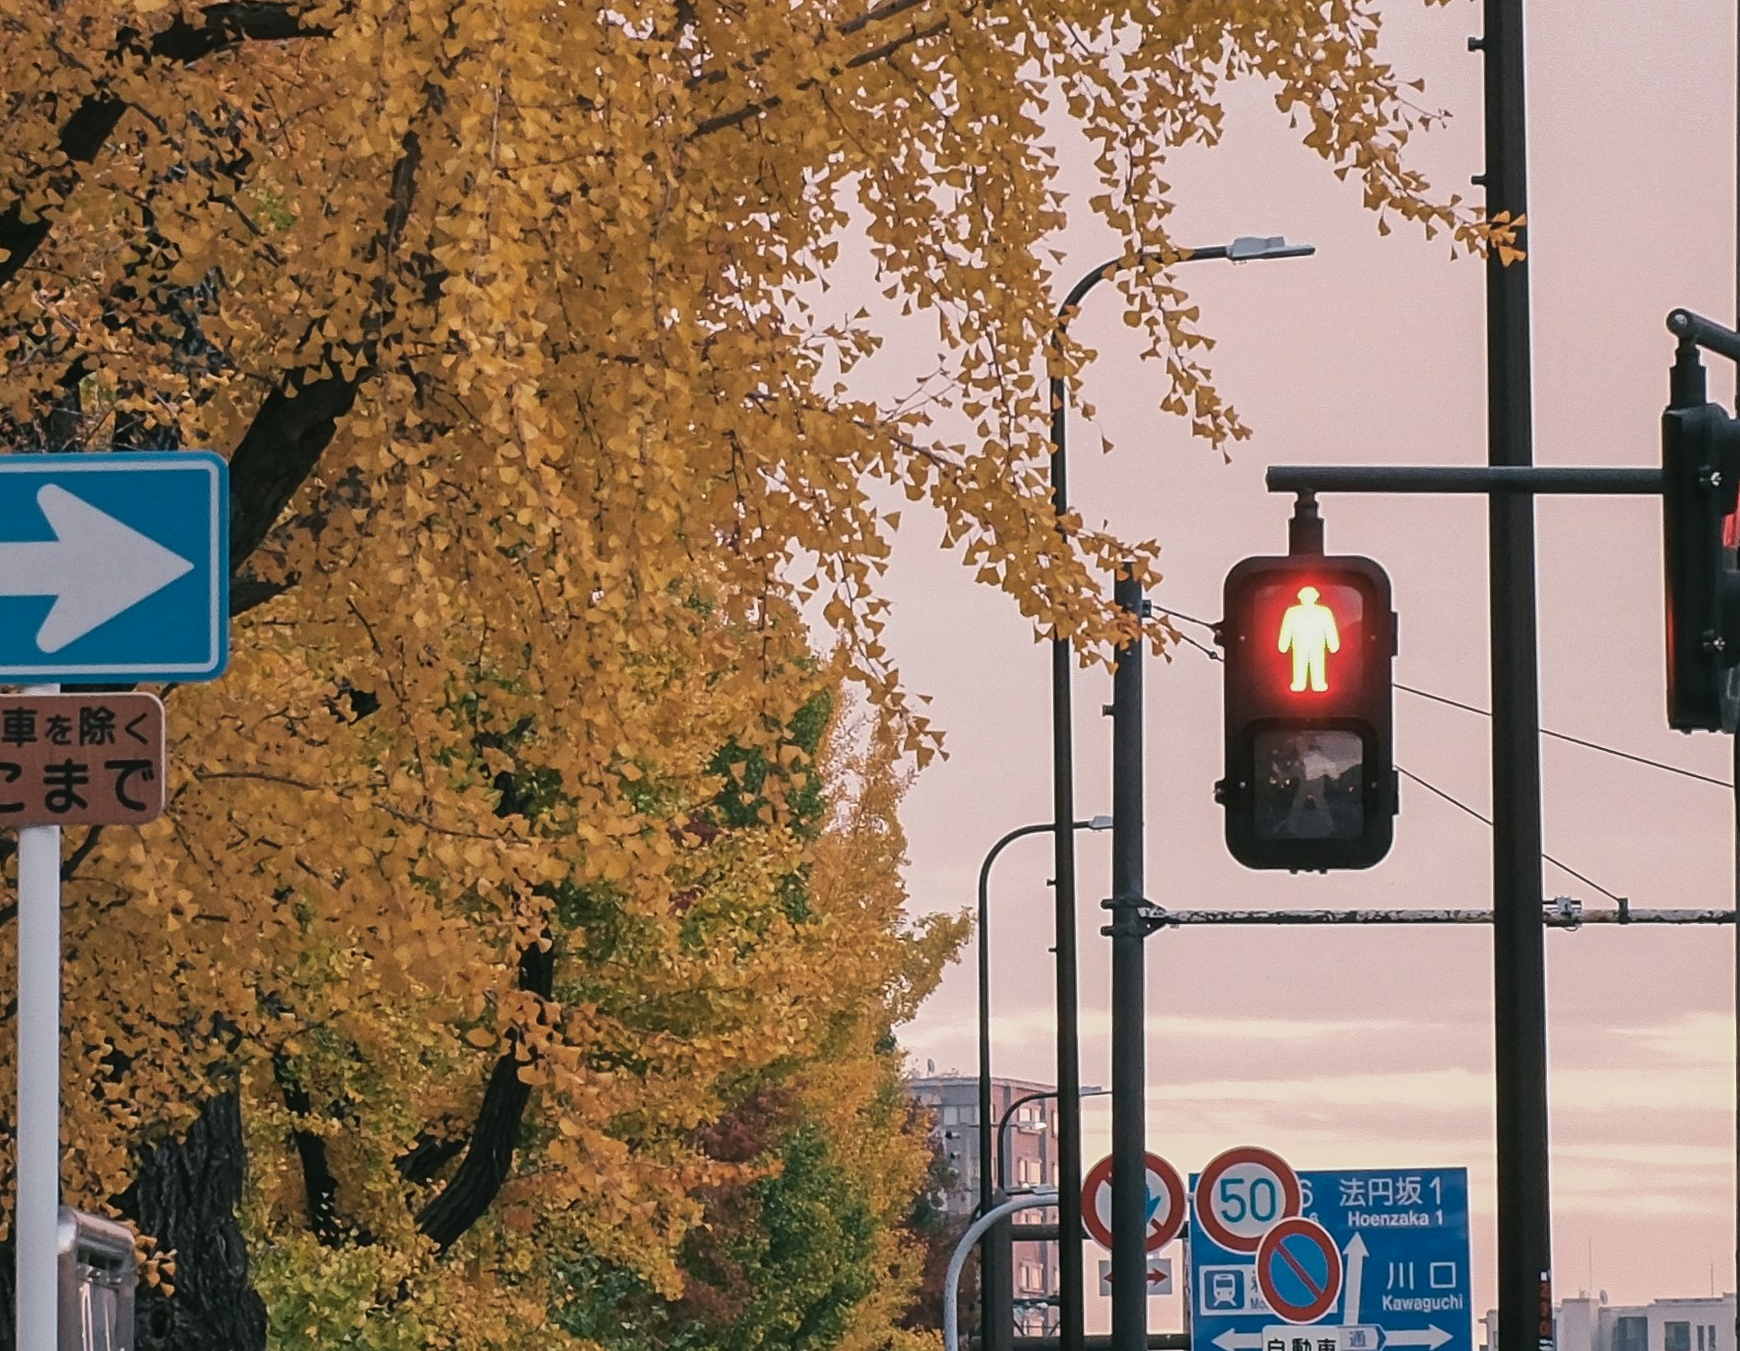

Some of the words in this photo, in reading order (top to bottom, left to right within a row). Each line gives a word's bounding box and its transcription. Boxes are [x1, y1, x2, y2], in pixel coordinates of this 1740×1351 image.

[1219, 1177, 1277, 1224] 50
[1347, 1210, 1430, 1227] Hoenzaka
[1436, 1209, 1444, 1226] 1
[1386, 1261, 1457, 1291] 川口
[1381, 1293, 1464, 1313] Kawaguchi
